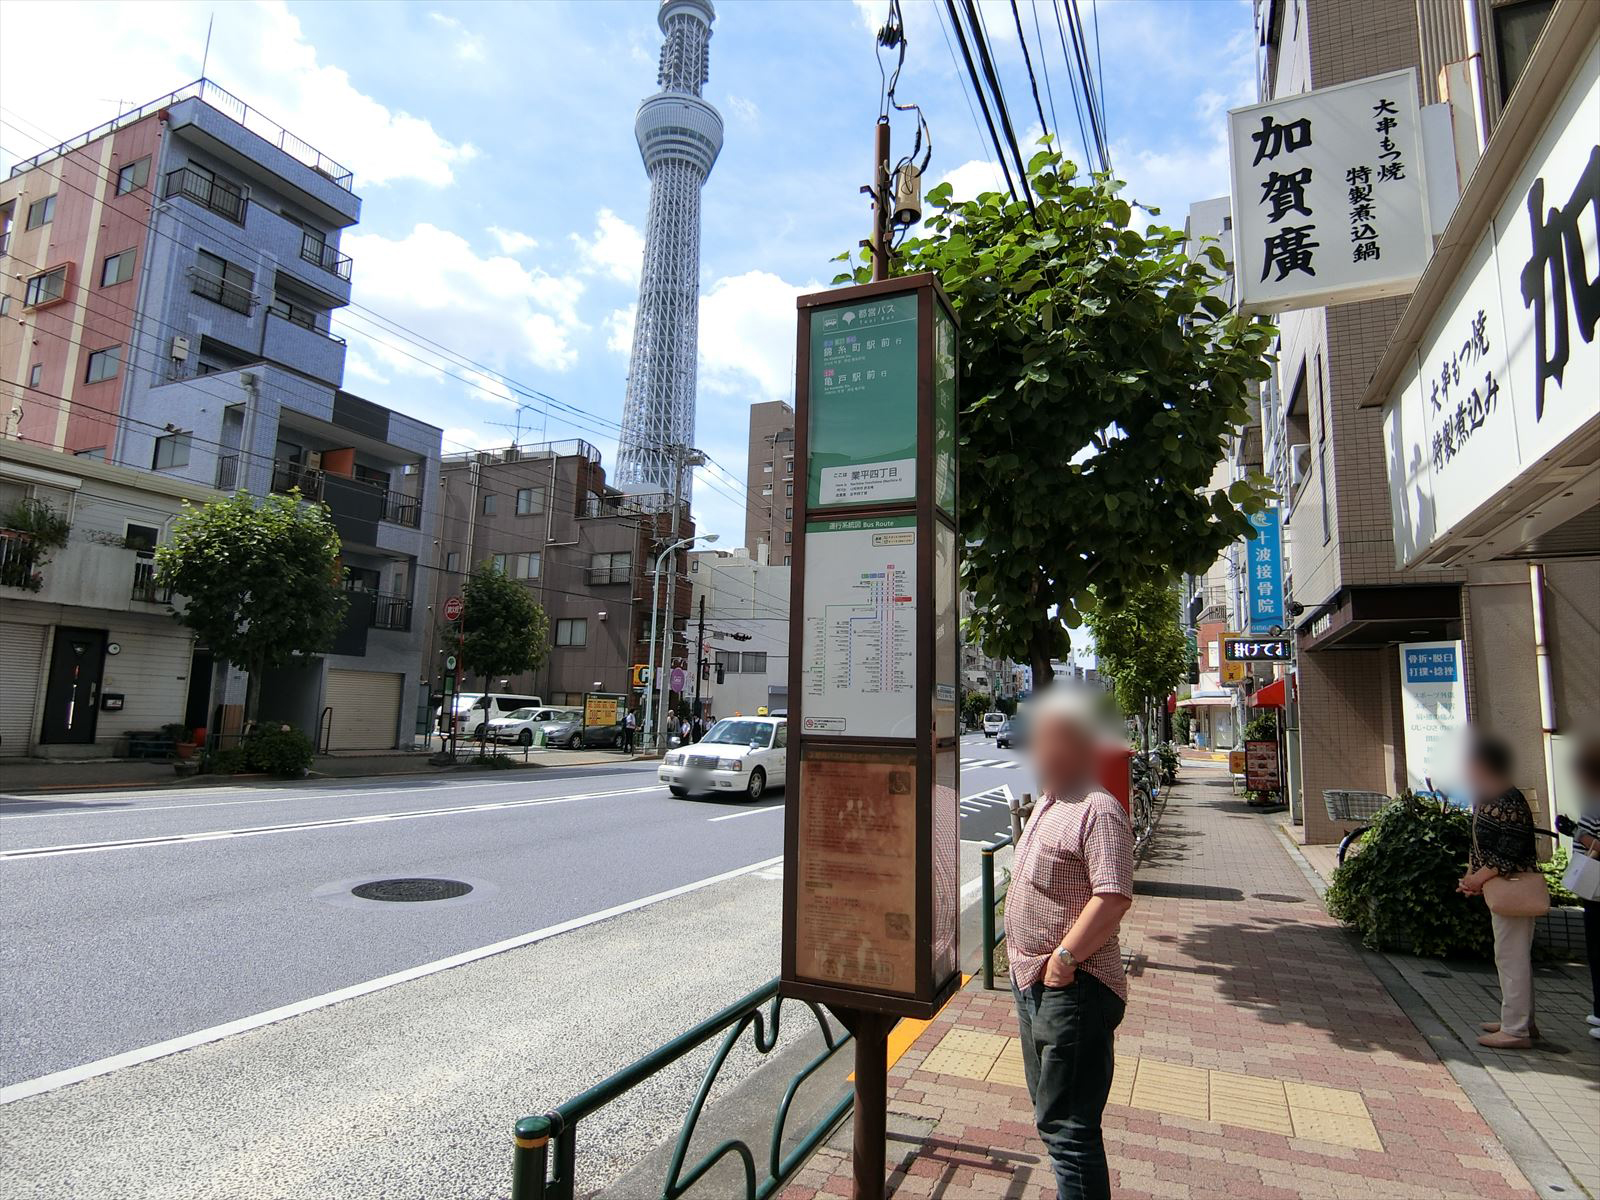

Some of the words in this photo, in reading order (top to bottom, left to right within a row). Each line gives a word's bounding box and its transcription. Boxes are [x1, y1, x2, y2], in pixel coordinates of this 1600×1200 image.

[1373, 99, 1406, 183] 大串もつ焼
[1251, 116, 1320, 283] 加賀廣
[1346, 165, 1381, 263] 特製煮込鍋
[1430, 309, 1490, 421] 大串もつ焼
[1432, 371, 1500, 474] 特製煮込み
[851, 467, 897, 480] 業平四丁目
